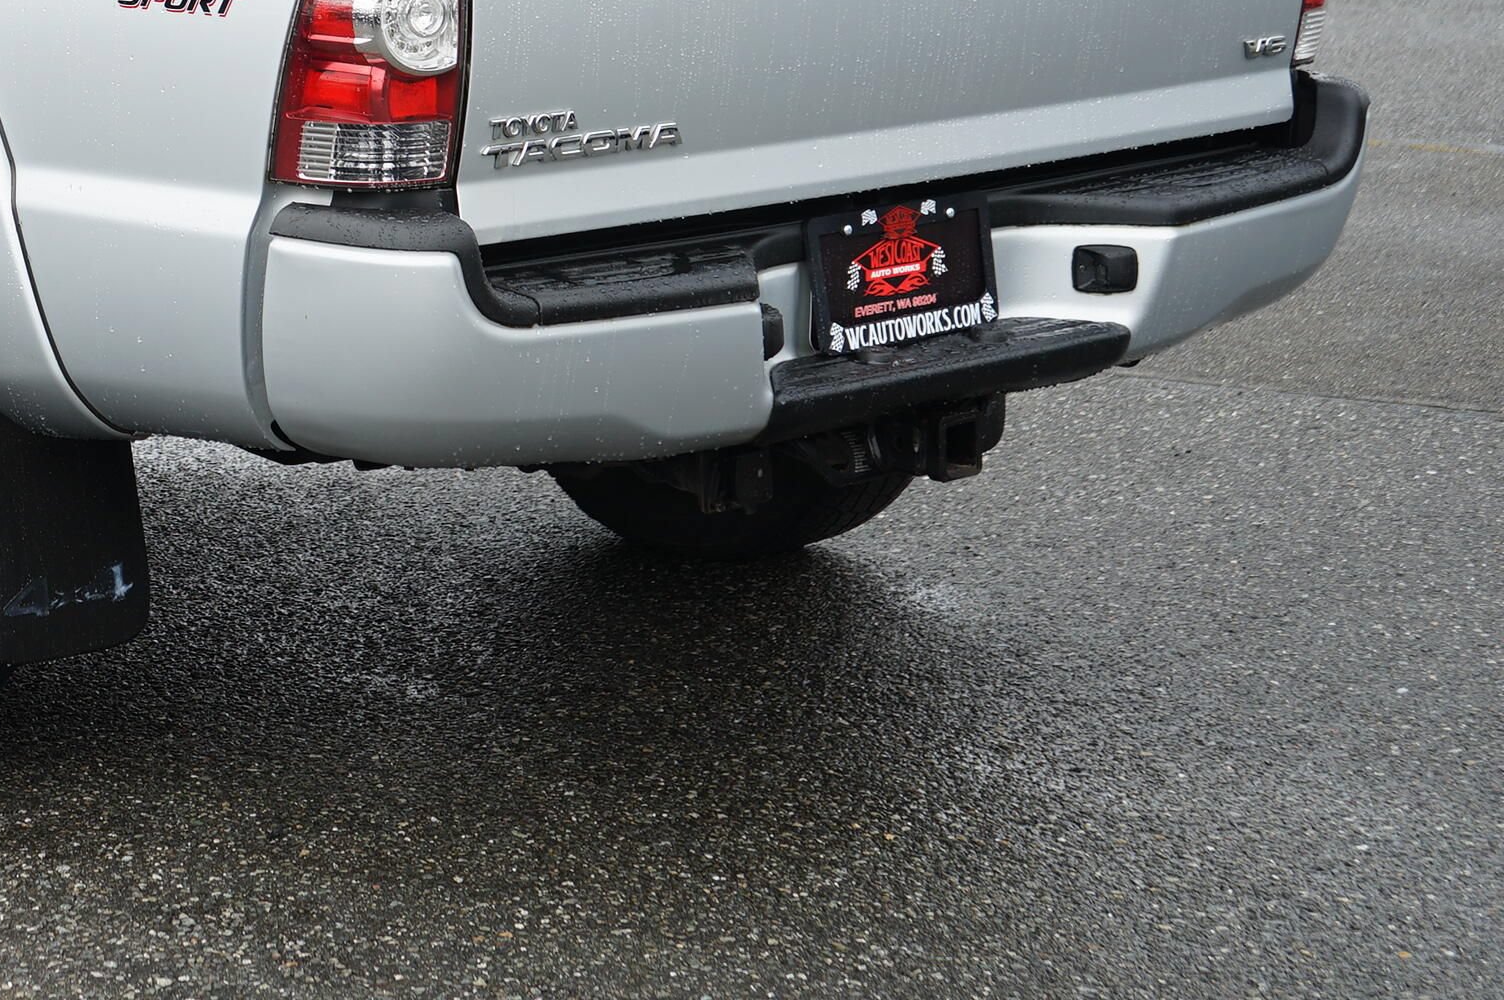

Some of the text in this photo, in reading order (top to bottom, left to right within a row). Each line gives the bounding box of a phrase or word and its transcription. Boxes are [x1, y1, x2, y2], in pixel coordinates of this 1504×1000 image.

[489, 109, 579, 141] TOYOTA
[480, 122, 683, 169] TACOMA
[871, 263, 921, 279] AUTO WORKS
[896, 296, 912, 310] WA
[846, 302, 982, 351] WCAUTOWORKS.COM
